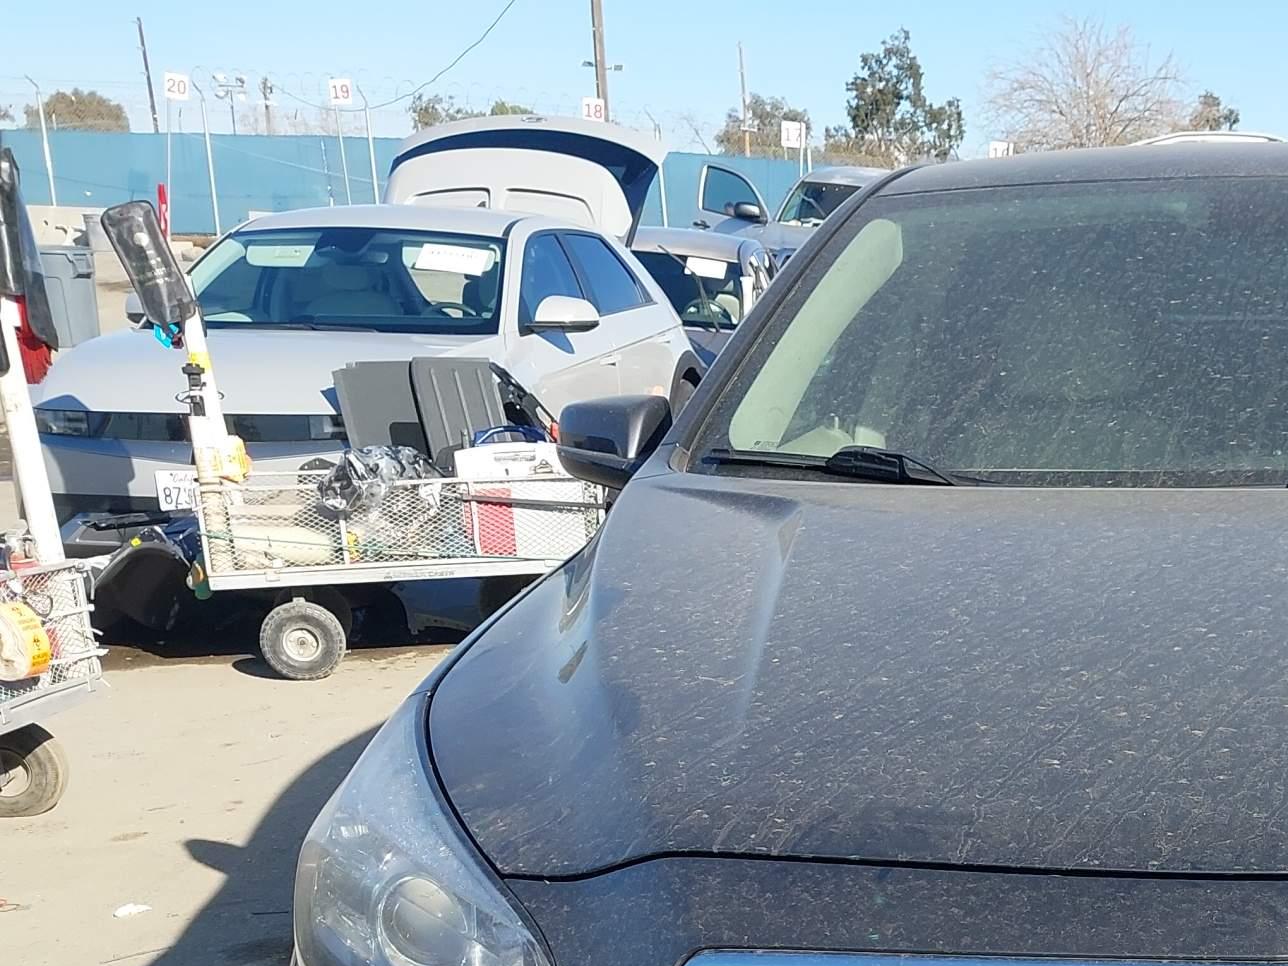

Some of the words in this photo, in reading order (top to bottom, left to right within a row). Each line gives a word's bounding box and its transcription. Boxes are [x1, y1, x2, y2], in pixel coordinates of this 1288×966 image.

[167, 78, 187, 95] 20
[331, 84, 350, 99] 19
[584, 103, 603, 119] 18
